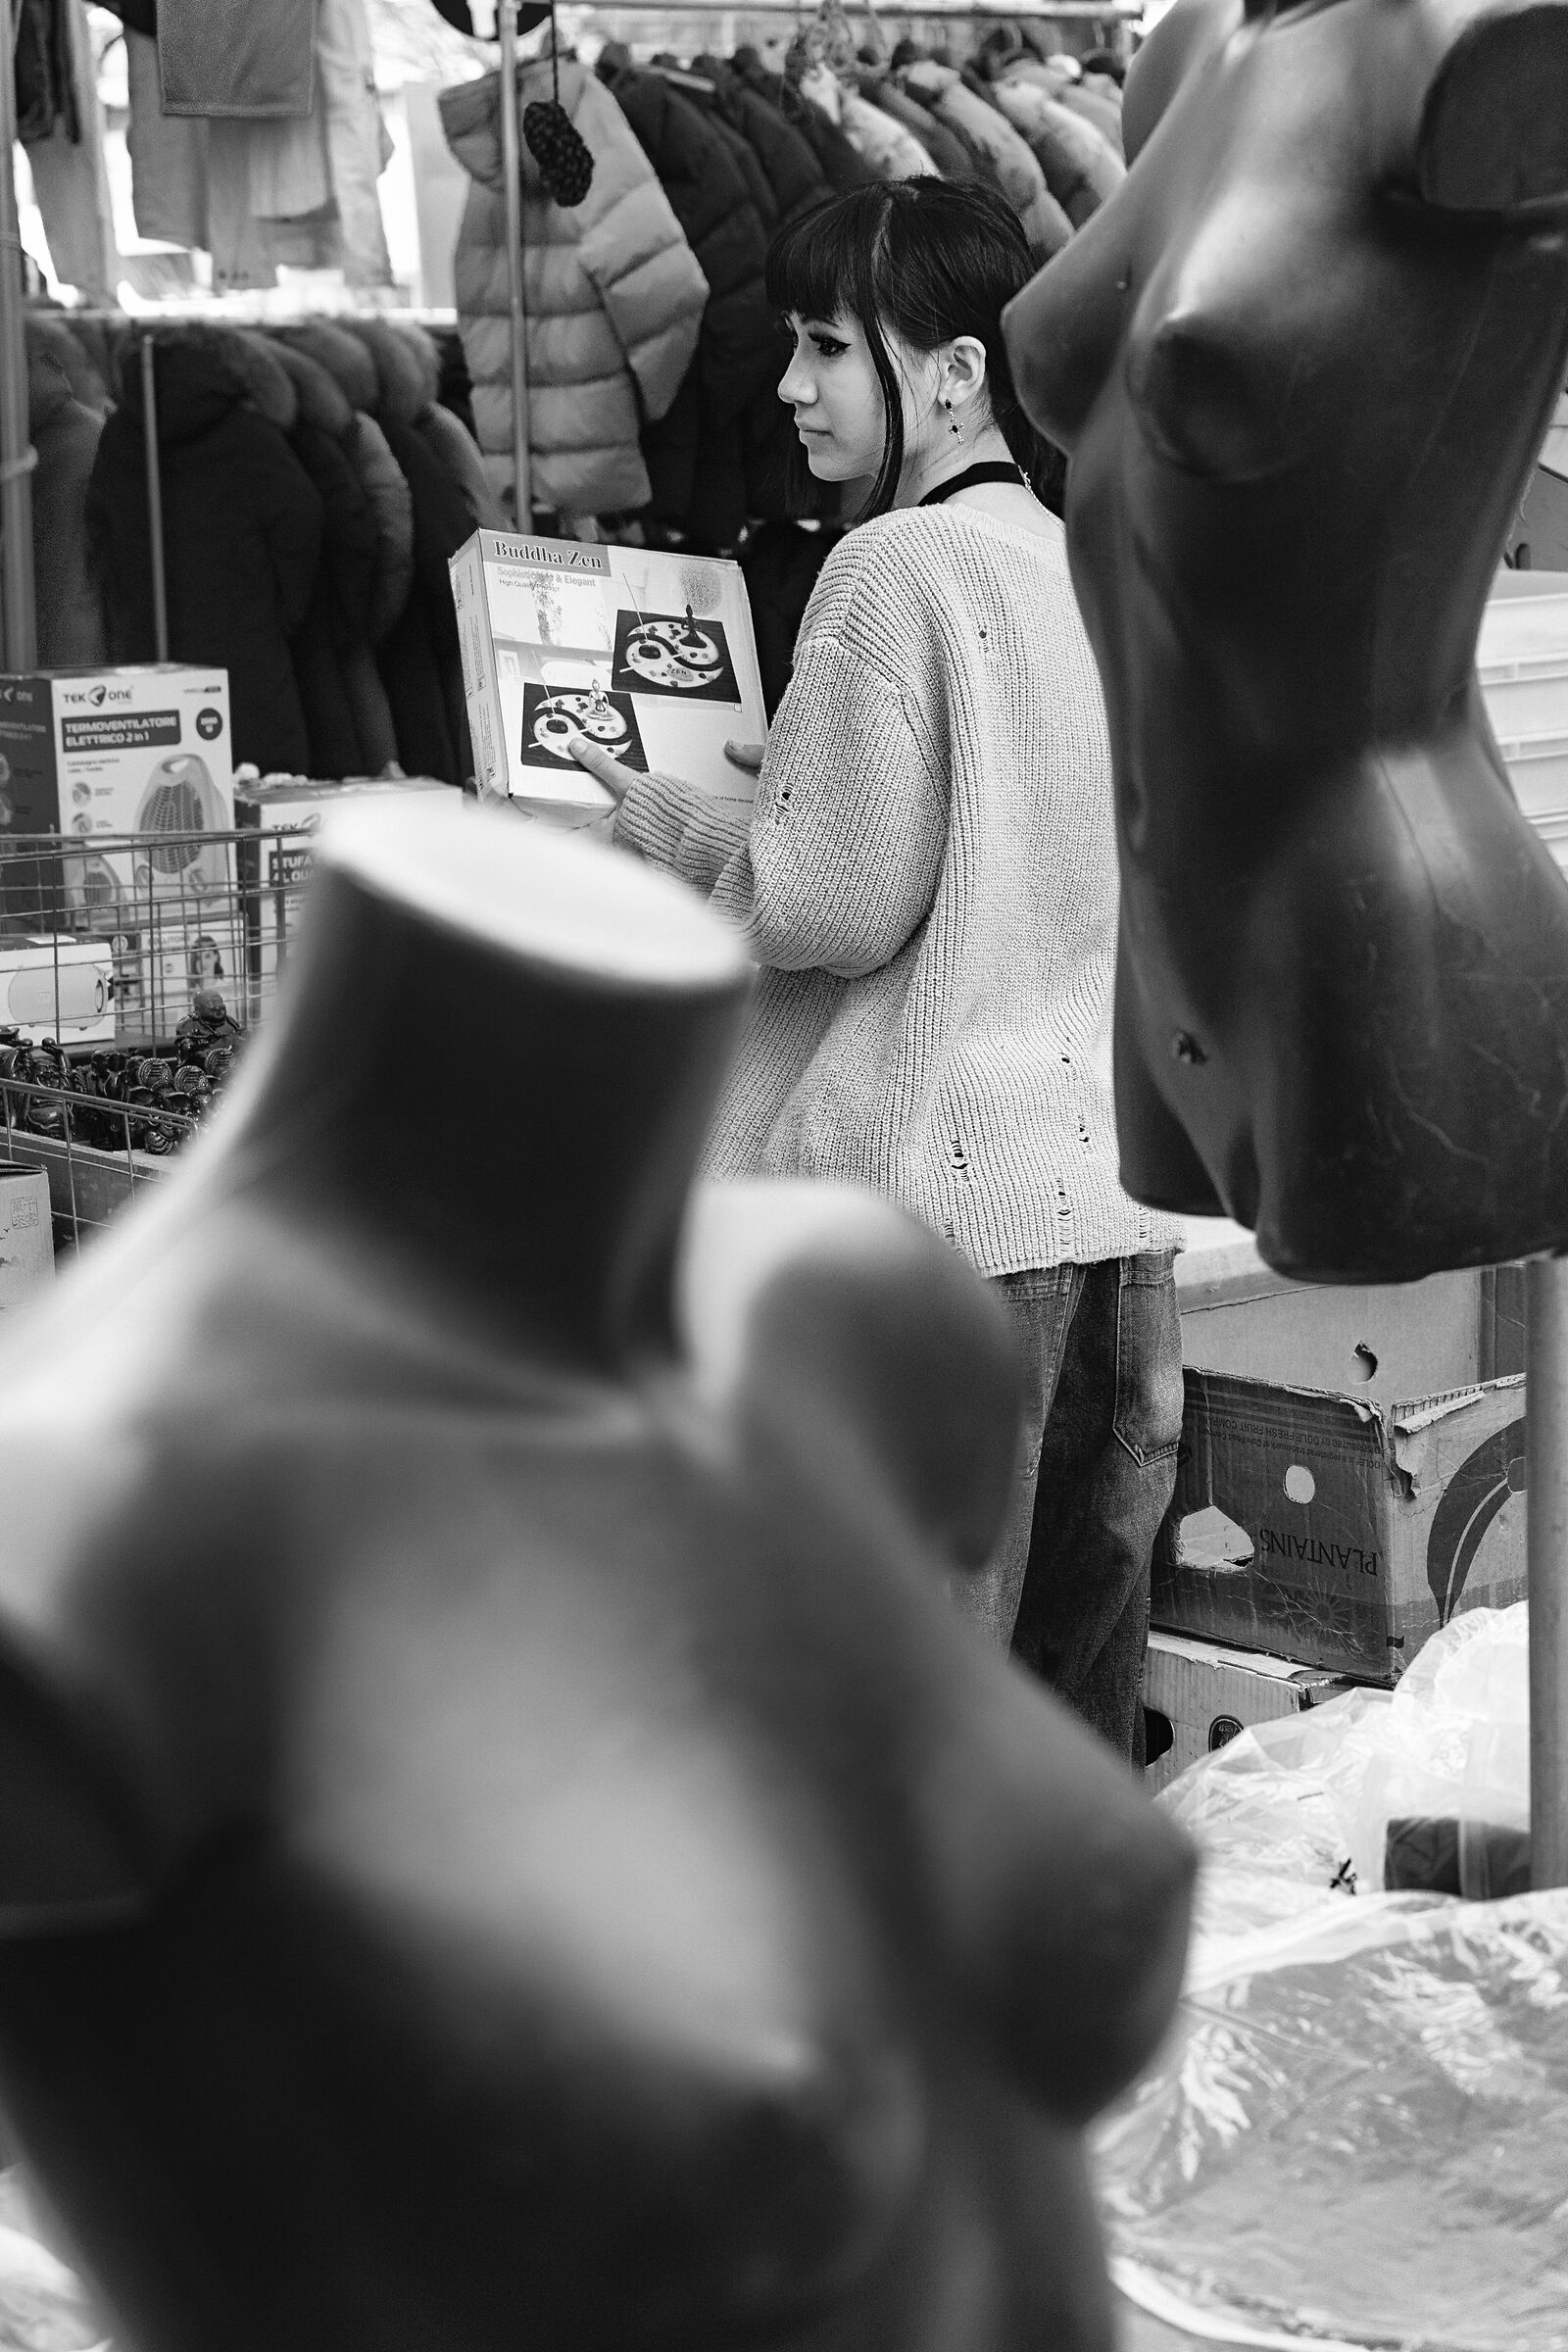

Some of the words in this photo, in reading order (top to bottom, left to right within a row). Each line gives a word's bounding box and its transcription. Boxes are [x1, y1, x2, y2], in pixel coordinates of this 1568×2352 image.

[494, 541, 563, 564] Buddha
[568, 550, 603, 568] Zen
[499, 578, 514, 587] High
[556, 573, 563, 583] &
[564, 575, 596, 588] Elegant
[65, 715, 177, 735] TERMOVENTILATORE
[66, 733, 124, 747] ELETTRICO
[1240, 1423, 1263, 1435] FRUIT
[1266, 1426, 1294, 1441] FRESH
[1229, 1433, 1246, 1445] Food
[1246, 1437, 1262, 1447] Dole
[1297, 1432, 1320, 1446] DOLE
[1272, 1442, 1305, 1455] trademark
[1259, 1529, 1378, 1576] PLANTAINS
